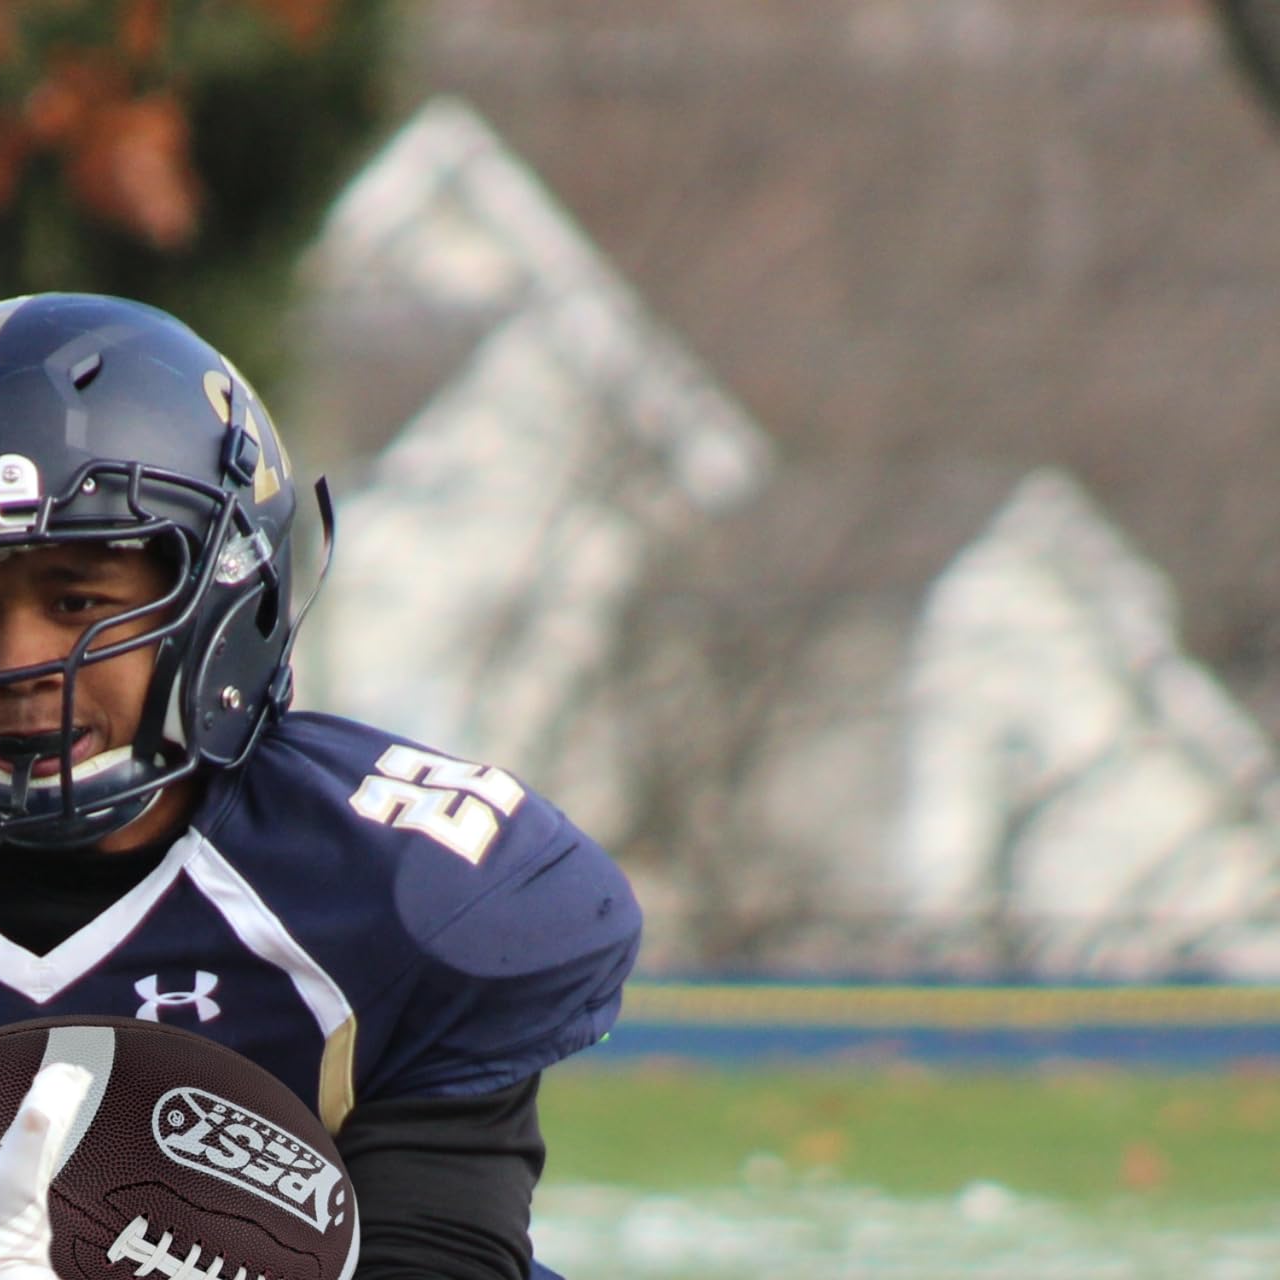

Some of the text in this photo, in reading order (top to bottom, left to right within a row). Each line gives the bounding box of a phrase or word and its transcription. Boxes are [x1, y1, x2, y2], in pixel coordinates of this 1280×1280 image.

[348, 744, 526, 866] 22
[163, 1110, 327, 1205] BEST
[213, 1103, 323, 1168] SPORTING
